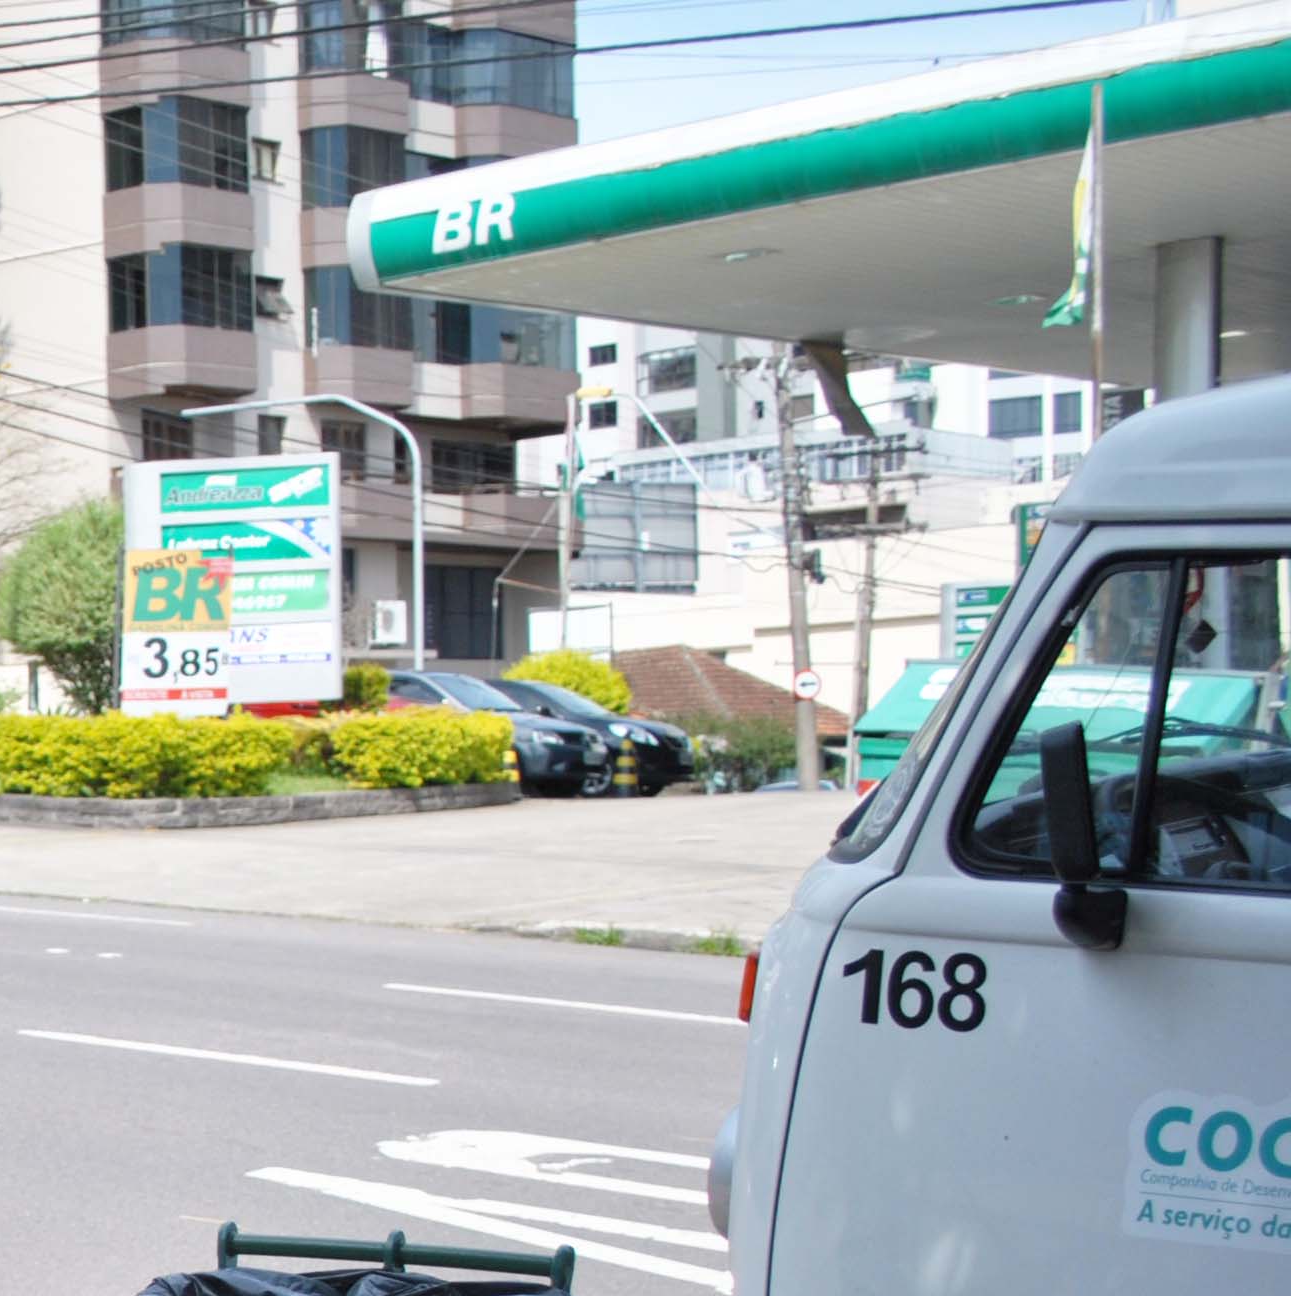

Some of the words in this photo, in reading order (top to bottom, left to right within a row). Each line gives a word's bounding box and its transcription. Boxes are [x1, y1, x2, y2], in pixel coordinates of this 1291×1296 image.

[432, 190, 515, 254] BR
[165, 486, 263, 506] Andreazza
[132, 553, 187, 577] POSTO
[132, 566, 225, 622] BR
[842, 948, 987, 1032] 168
[1139, 1168, 1218, 1191] Companhia
[1220, 1178, 1239, 1194] de
[1136, 1199, 1155, 1223] A
[1162, 1207, 1251, 1240] serviço
